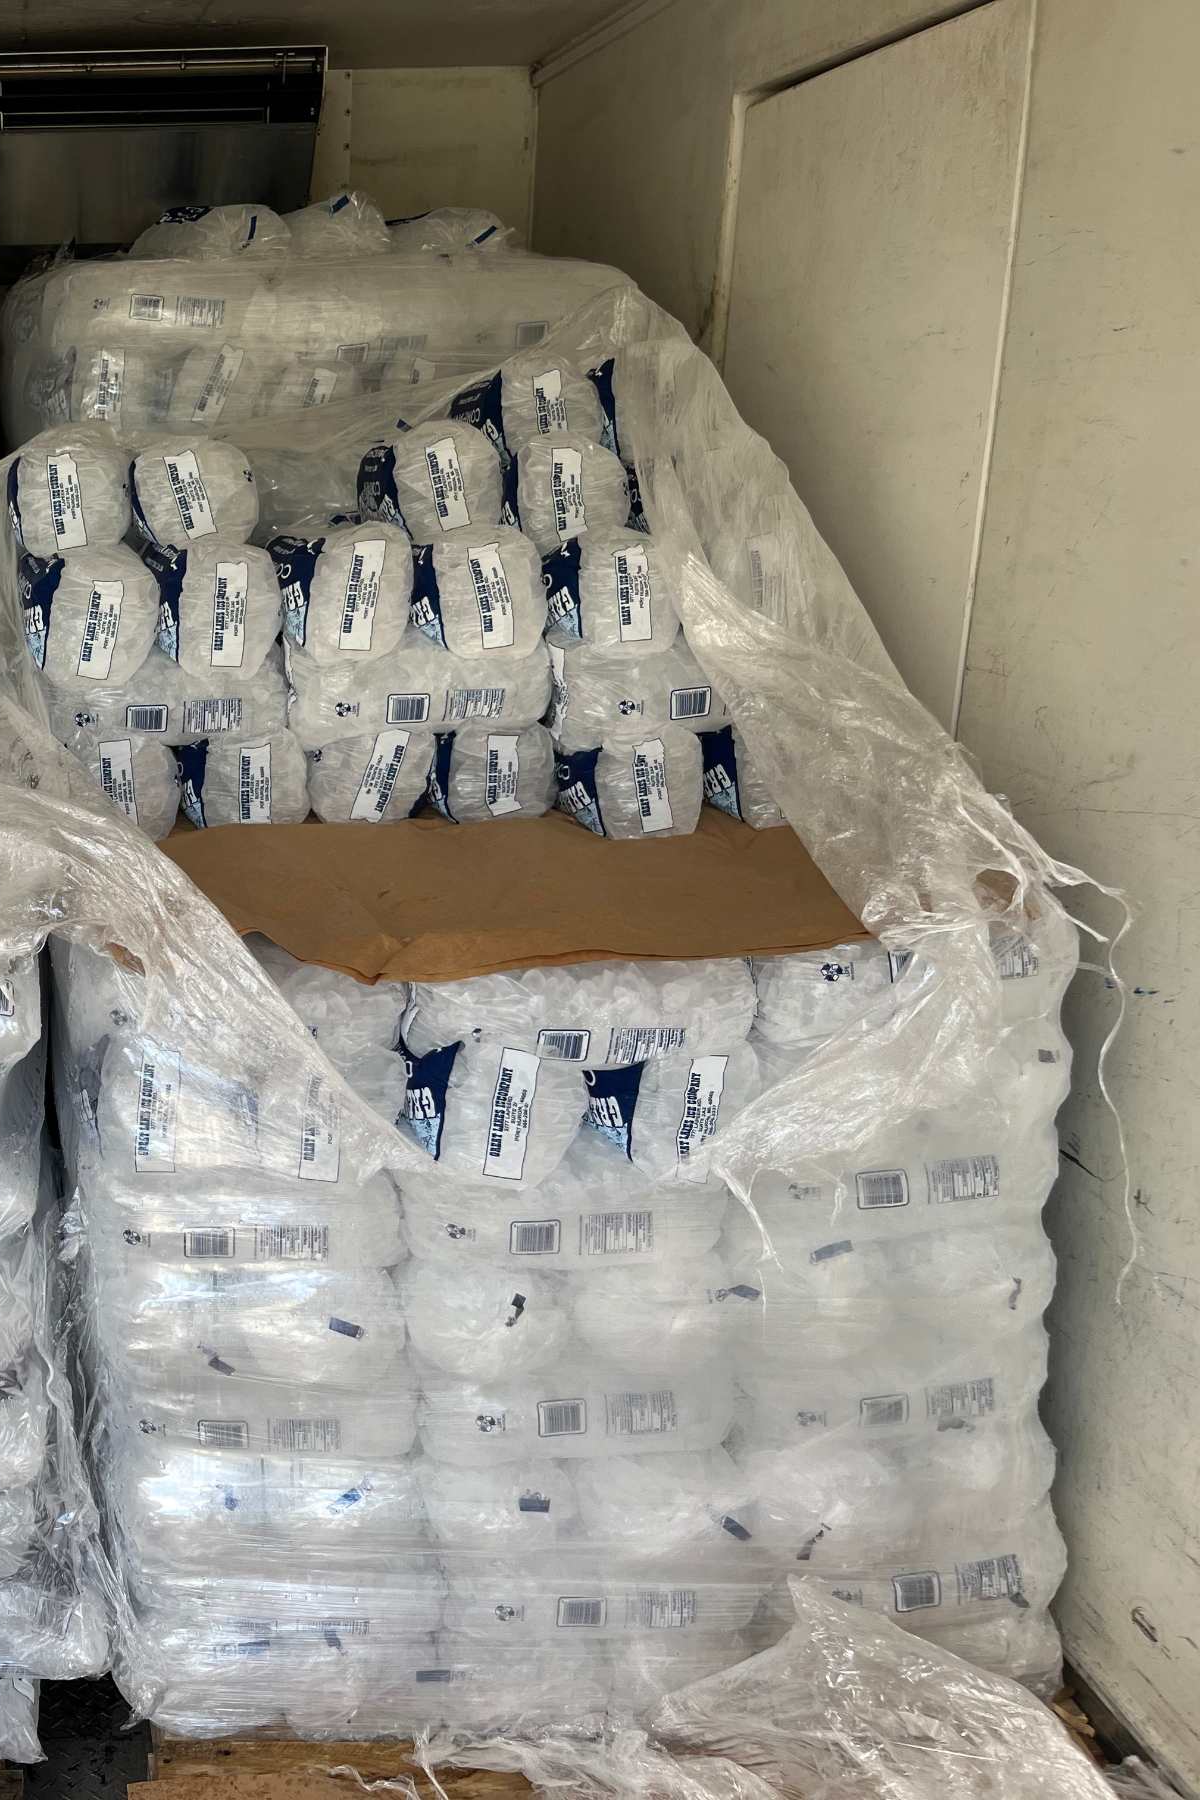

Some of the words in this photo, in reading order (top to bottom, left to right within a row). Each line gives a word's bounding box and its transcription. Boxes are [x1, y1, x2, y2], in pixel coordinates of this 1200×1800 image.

[48, 463, 59, 489] COMPANY
[52, 500, 62, 517] LAKES
[55, 518, 65, 534] GREAT
[350, 554, 363, 583] COMPANY
[469, 558, 484, 584] COMPANY
[348, 583, 358, 592] ICE
[477, 584, 487, 595] ICE
[619, 575, 628, 585] ICE
[345, 593, 356, 612] LAKES
[478, 595, 490, 613] LAKES
[619, 586, 629, 604] LAKES
[214, 611, 224, 630] LAKES
[342, 613, 353, 633] GREAT
[481, 614, 494, 632] GREAT
[620, 605, 631, 625] GREAT
[85, 621, 97, 641] LAKES
[213, 631, 223, 650] GREAT
[81, 641, 93, 661] GREAT
[391, 744, 404, 763] GREAT
[487, 749, 498, 773] COMPANY
[101, 757, 113, 784] COMPANY
[385, 762, 398, 781] LAKES
[488, 774, 496, 783] ICE
[635, 768, 645, 778] ICE
[637, 778, 647, 796] LAKES
[639, 797, 651, 816] GREAT
[496, 1066, 513, 1101] COMPANY
[686, 1072, 701, 1105] COMPANY
[405, 1087, 437, 1120] GRE
[495, 1099, 507, 1107] IC
[589, 1095, 624, 1128] GRE
[685, 1105, 696, 1118] ICE
[491, 1108, 506, 1132] LAKES
[679, 1118, 693, 1140] LAKES
[488, 1133, 502, 1157] GREAT
